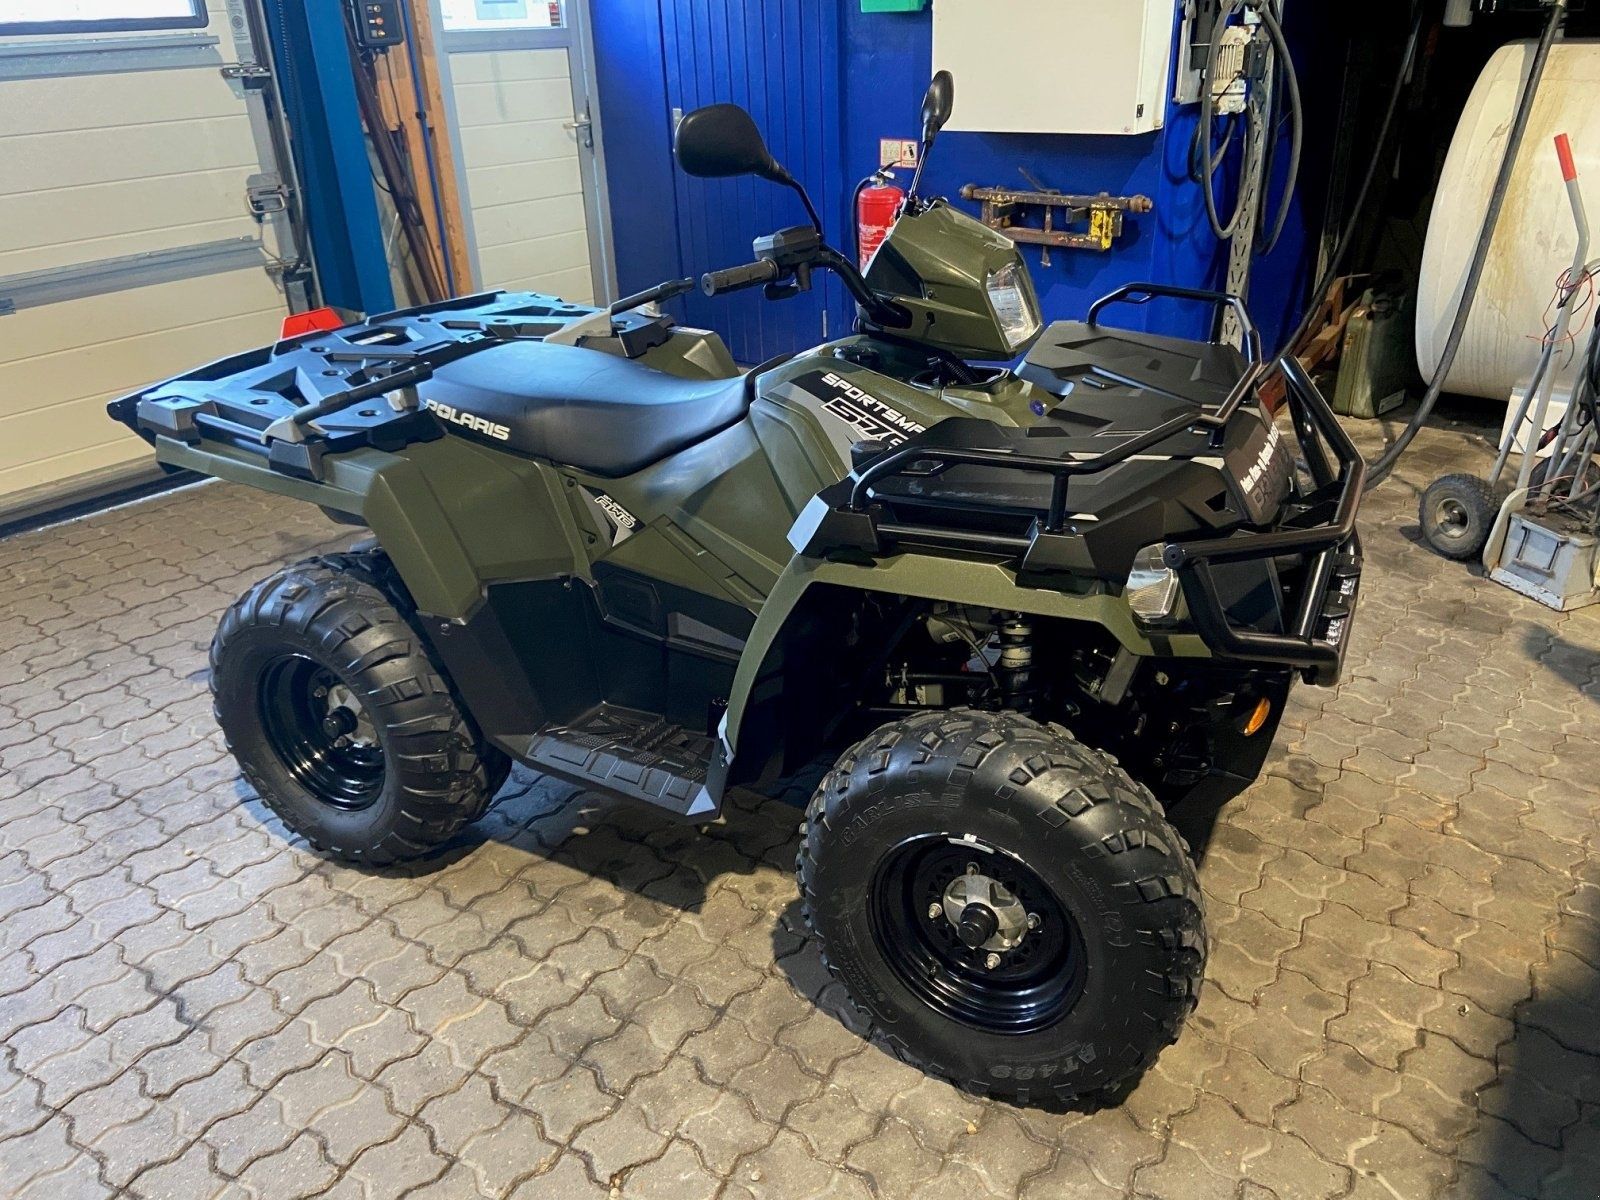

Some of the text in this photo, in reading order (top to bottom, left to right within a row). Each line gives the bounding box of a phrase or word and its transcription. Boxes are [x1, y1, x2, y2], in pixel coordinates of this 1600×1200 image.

[426, 399, 511, 441] POLARIS
[820, 397, 909, 450] 57
[821, 372, 927, 434] SPORTSMA
[594, 496, 635, 528] AWD
